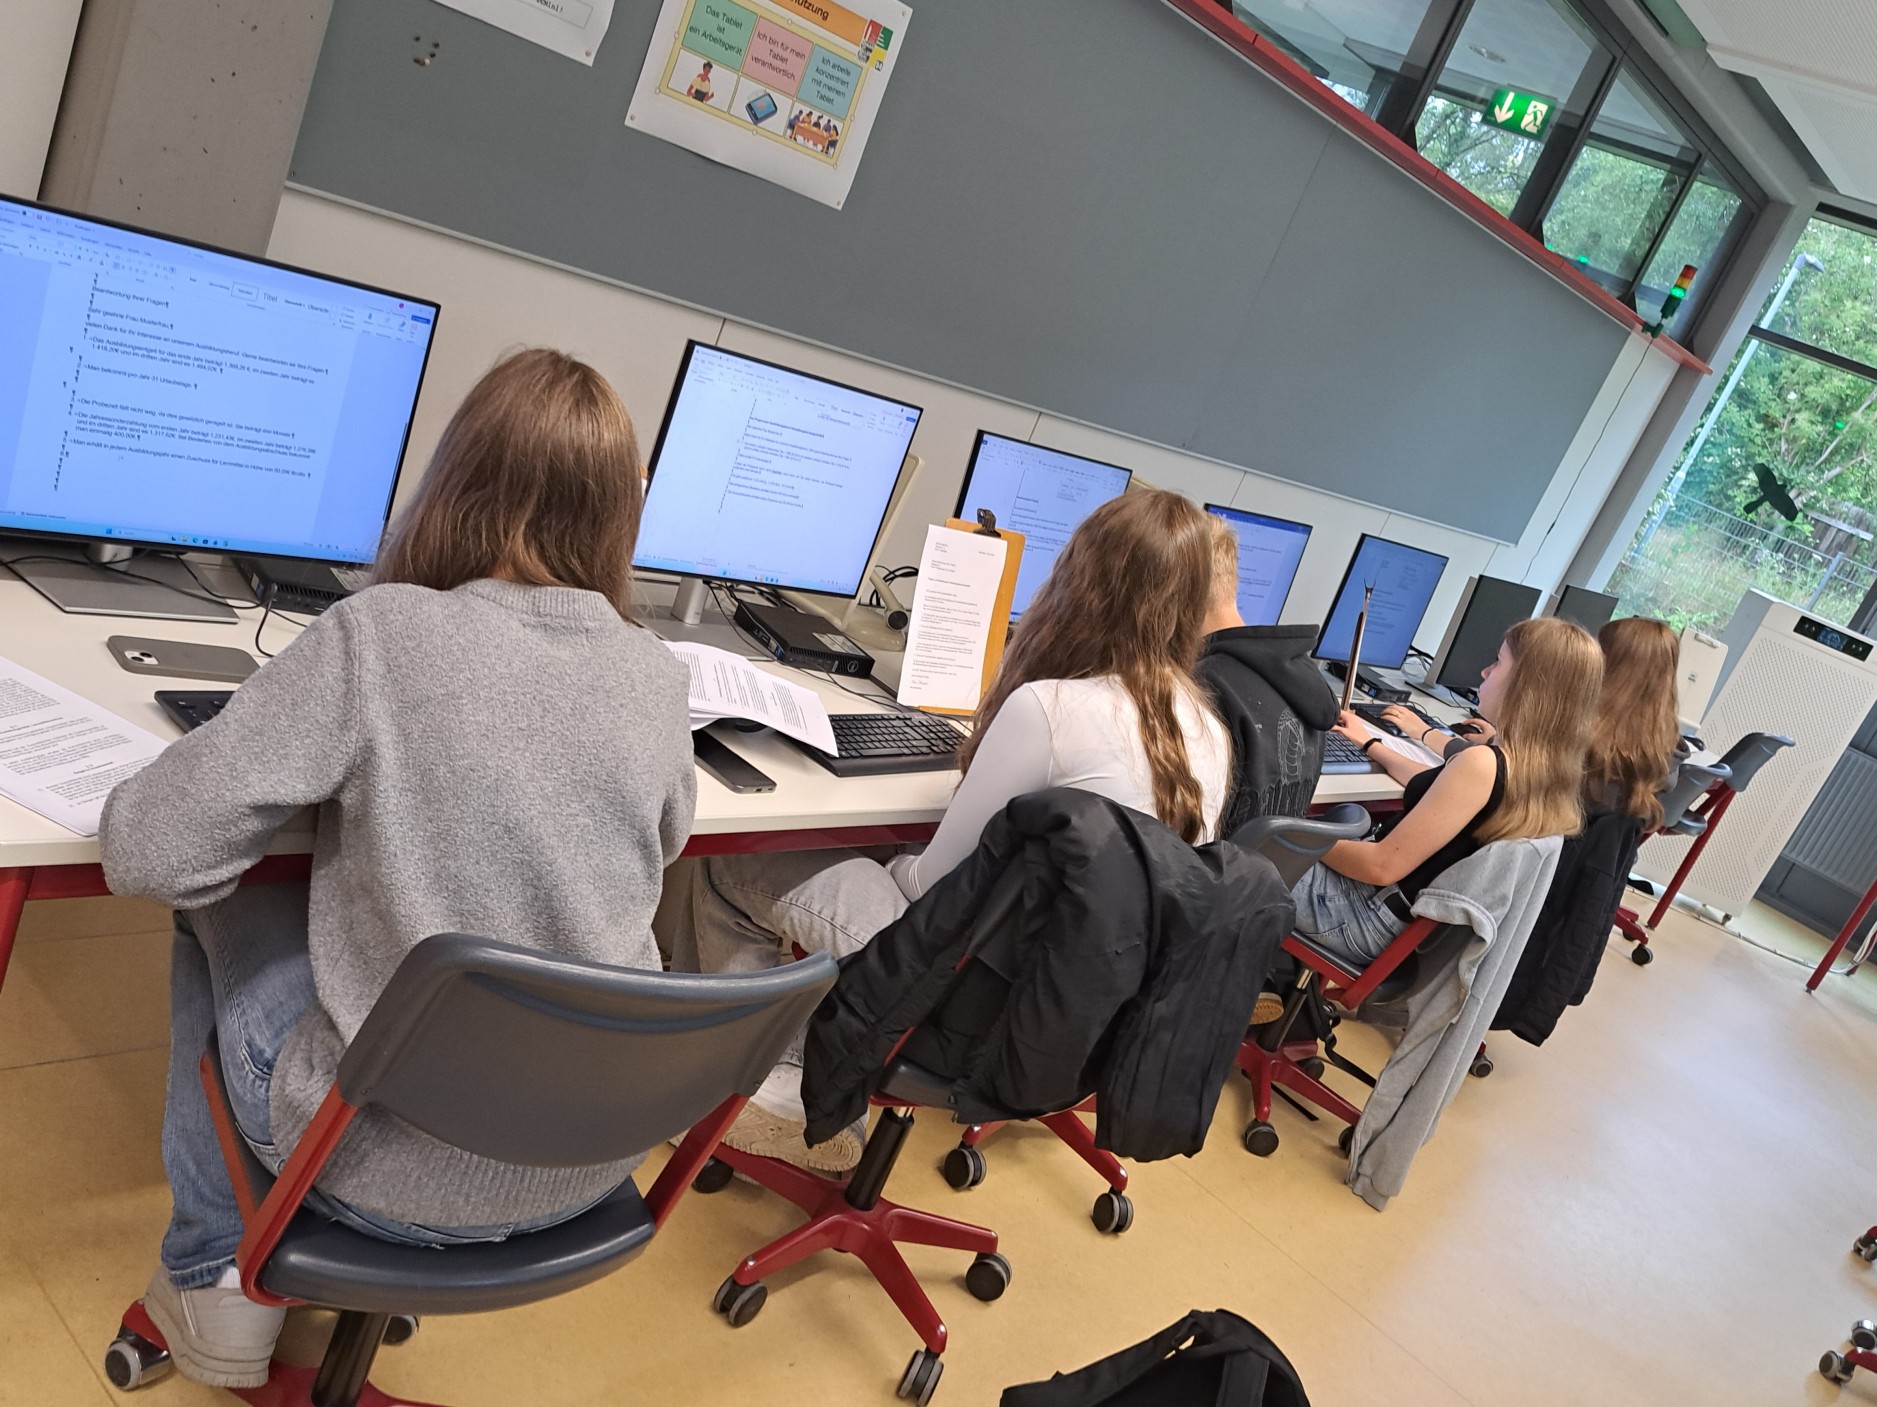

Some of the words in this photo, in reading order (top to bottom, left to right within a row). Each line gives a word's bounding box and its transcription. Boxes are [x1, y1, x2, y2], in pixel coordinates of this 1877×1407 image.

[706, 5, 720, 18] Das
[722, 12, 743, 30] Tablet
[689, 25, 701, 36] ein
[717, 24, 726, 35] ist
[757, 31, 768, 42] Ich
[769, 36, 779, 48] bin
[780, 42, 790, 52] für
[790, 48, 806, 60] mein
[769, 49, 789, 66] Tablet
[822, 56, 831, 66] Ich
[831, 63, 851, 77] arbeite
[816, 65, 849, 89] konzentriert
[812, 78, 823, 88] mit
[823, 83, 846, 99] meinem
[145, 297, 166, 307] Fragen
[263, 292, 278, 302] Titel
[101, 310, 124, 319] geehrte
[100, 366, 127, 376] bekommt
